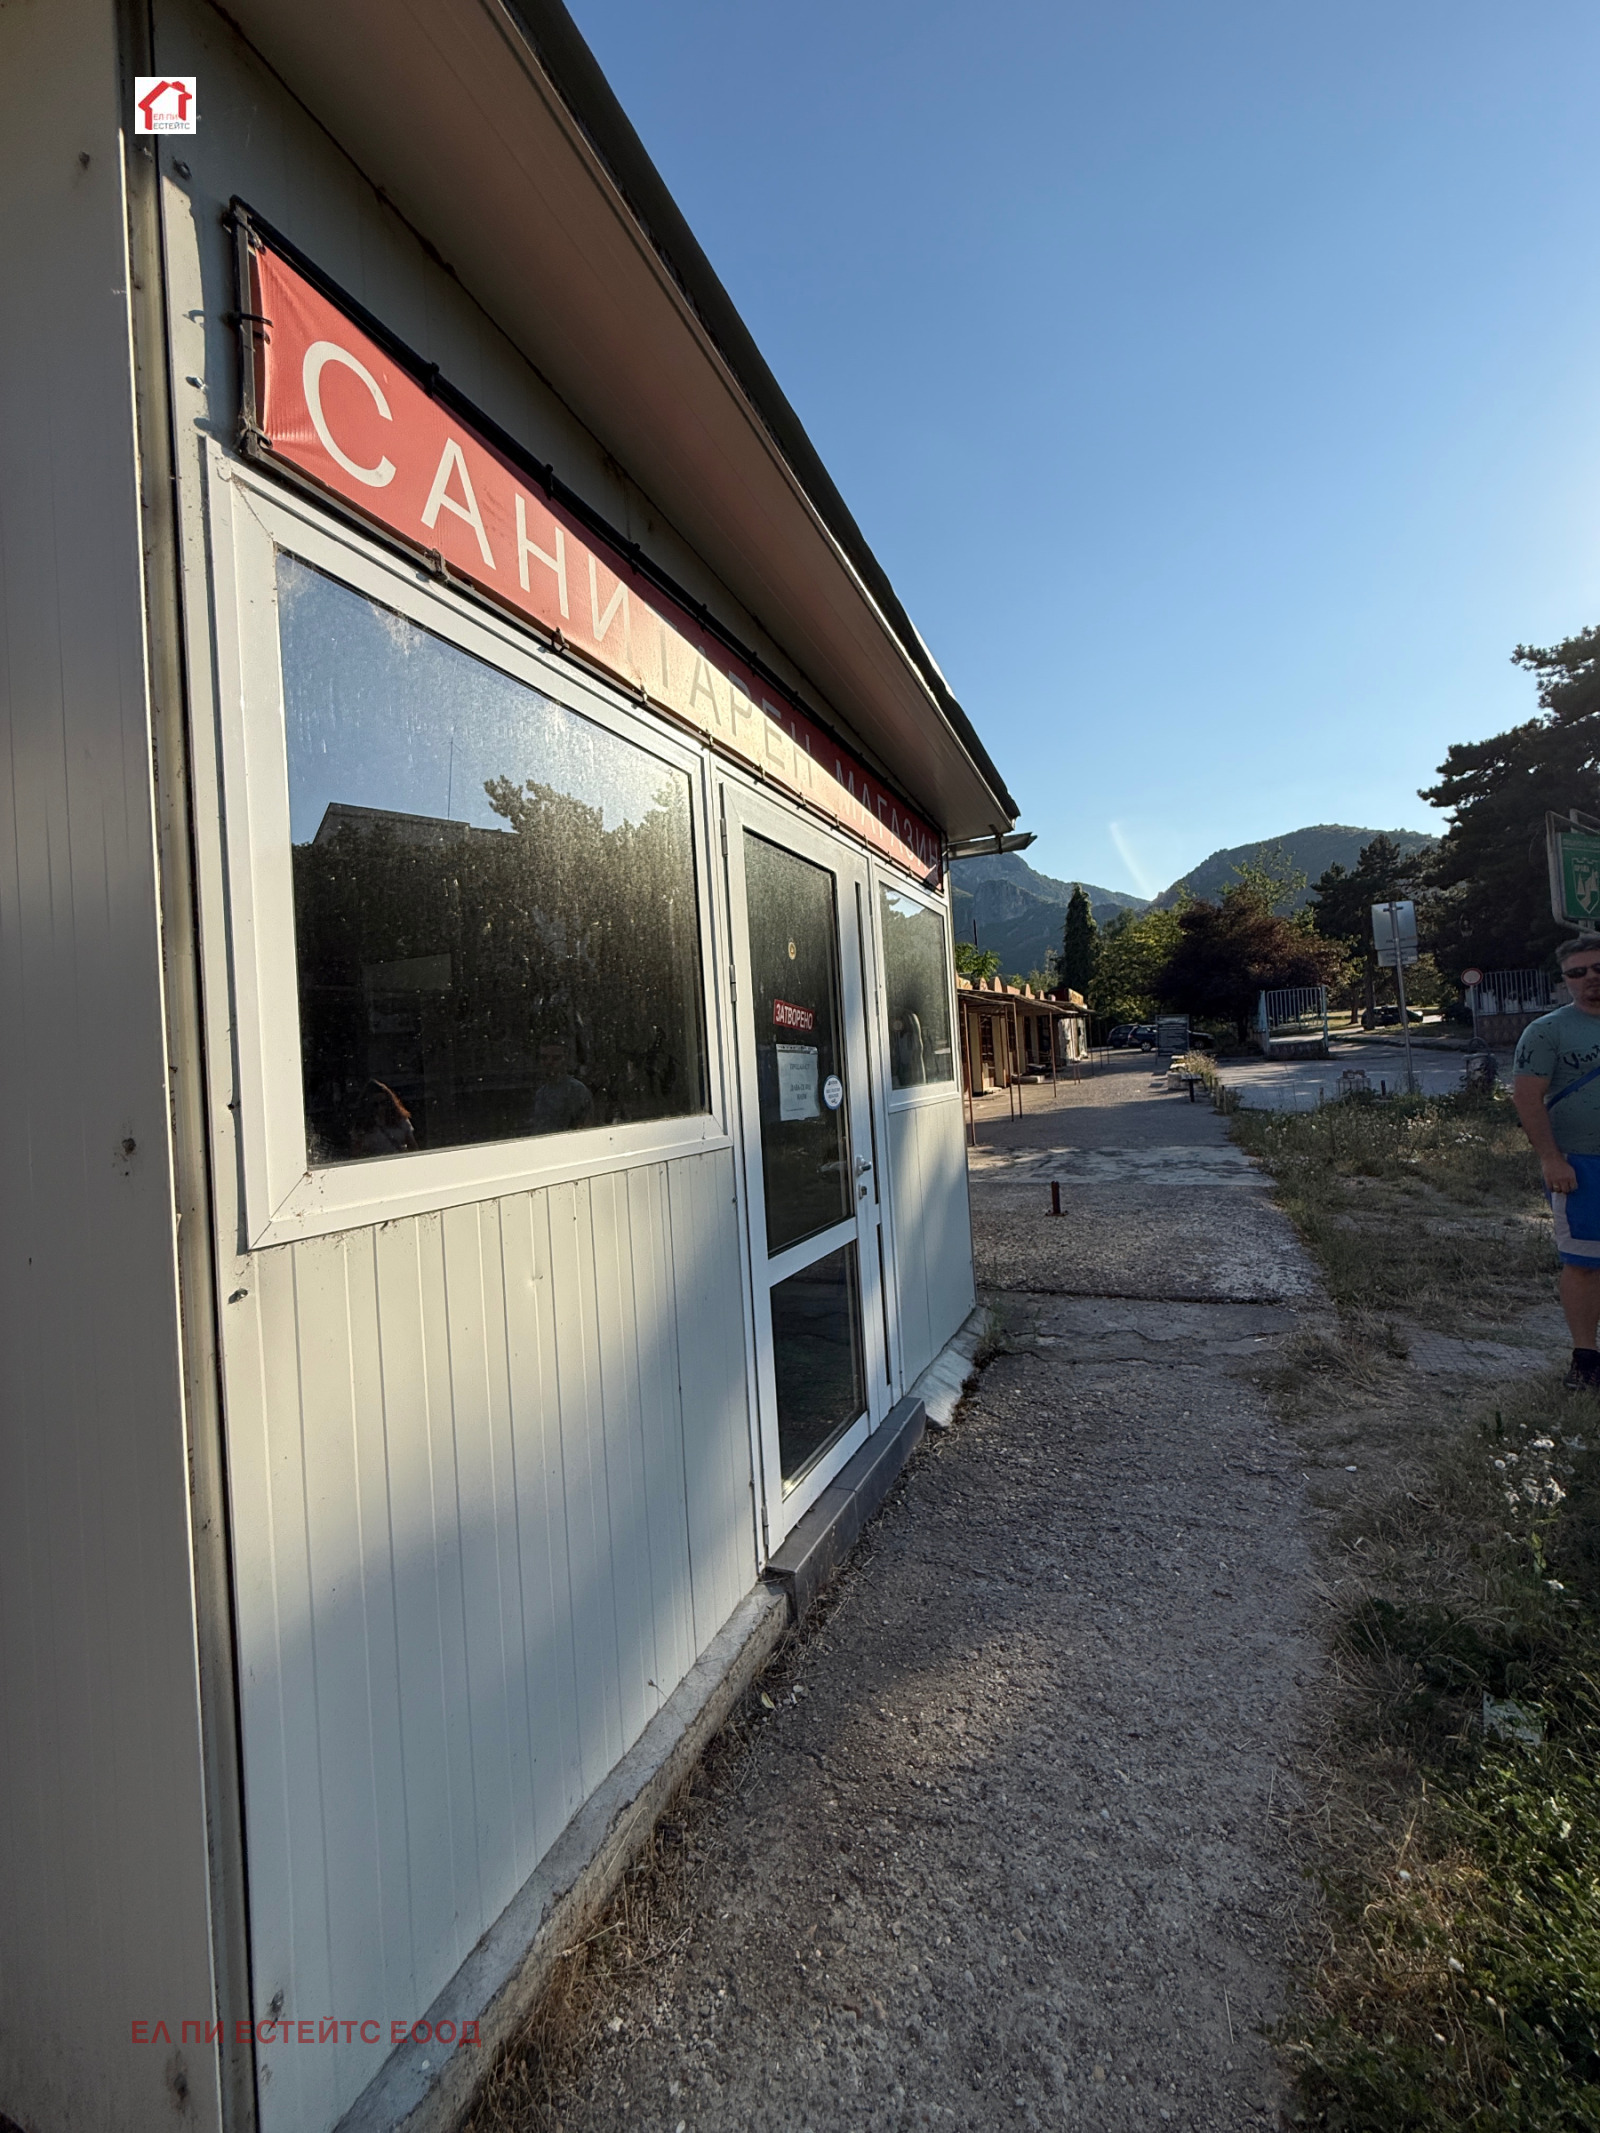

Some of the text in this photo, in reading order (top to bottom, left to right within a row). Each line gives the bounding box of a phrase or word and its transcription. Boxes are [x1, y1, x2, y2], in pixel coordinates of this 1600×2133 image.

[303, 341, 938, 874] САНИТАРЕН МАГАЗИН
[775, 1003, 813, 1030] ЗАТВОРЕНО
